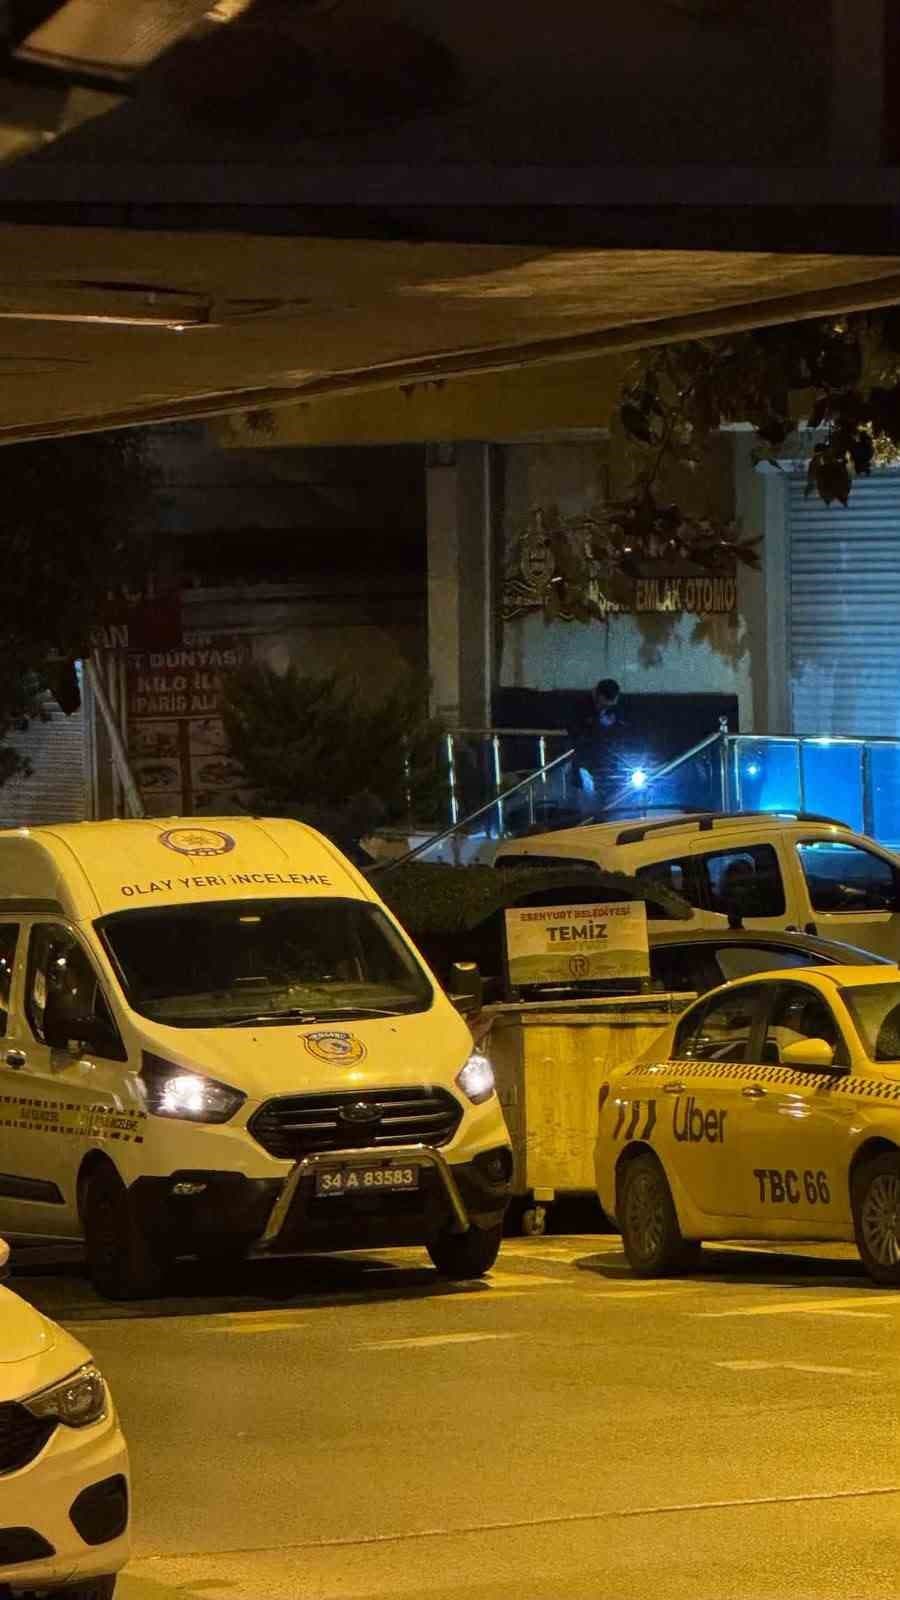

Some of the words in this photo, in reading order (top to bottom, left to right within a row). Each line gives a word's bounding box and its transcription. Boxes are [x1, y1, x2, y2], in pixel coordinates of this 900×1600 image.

[636, 578, 682, 611] EMLAK
[121, 879, 173, 897] OLAY
[229, 873, 333, 886] İNCELEME
[520, 909, 573, 922] ESENYURT
[546, 920, 608, 942] TEMİZ
[672, 1095, 728, 1143] Uber
[321, 1173, 341, 1190] 34
[346, 1174, 359, 1187] A
[363, 1169, 414, 1186] 83583
[753, 1168, 800, 1204] TBC
[803, 1169, 831, 1205] 66
